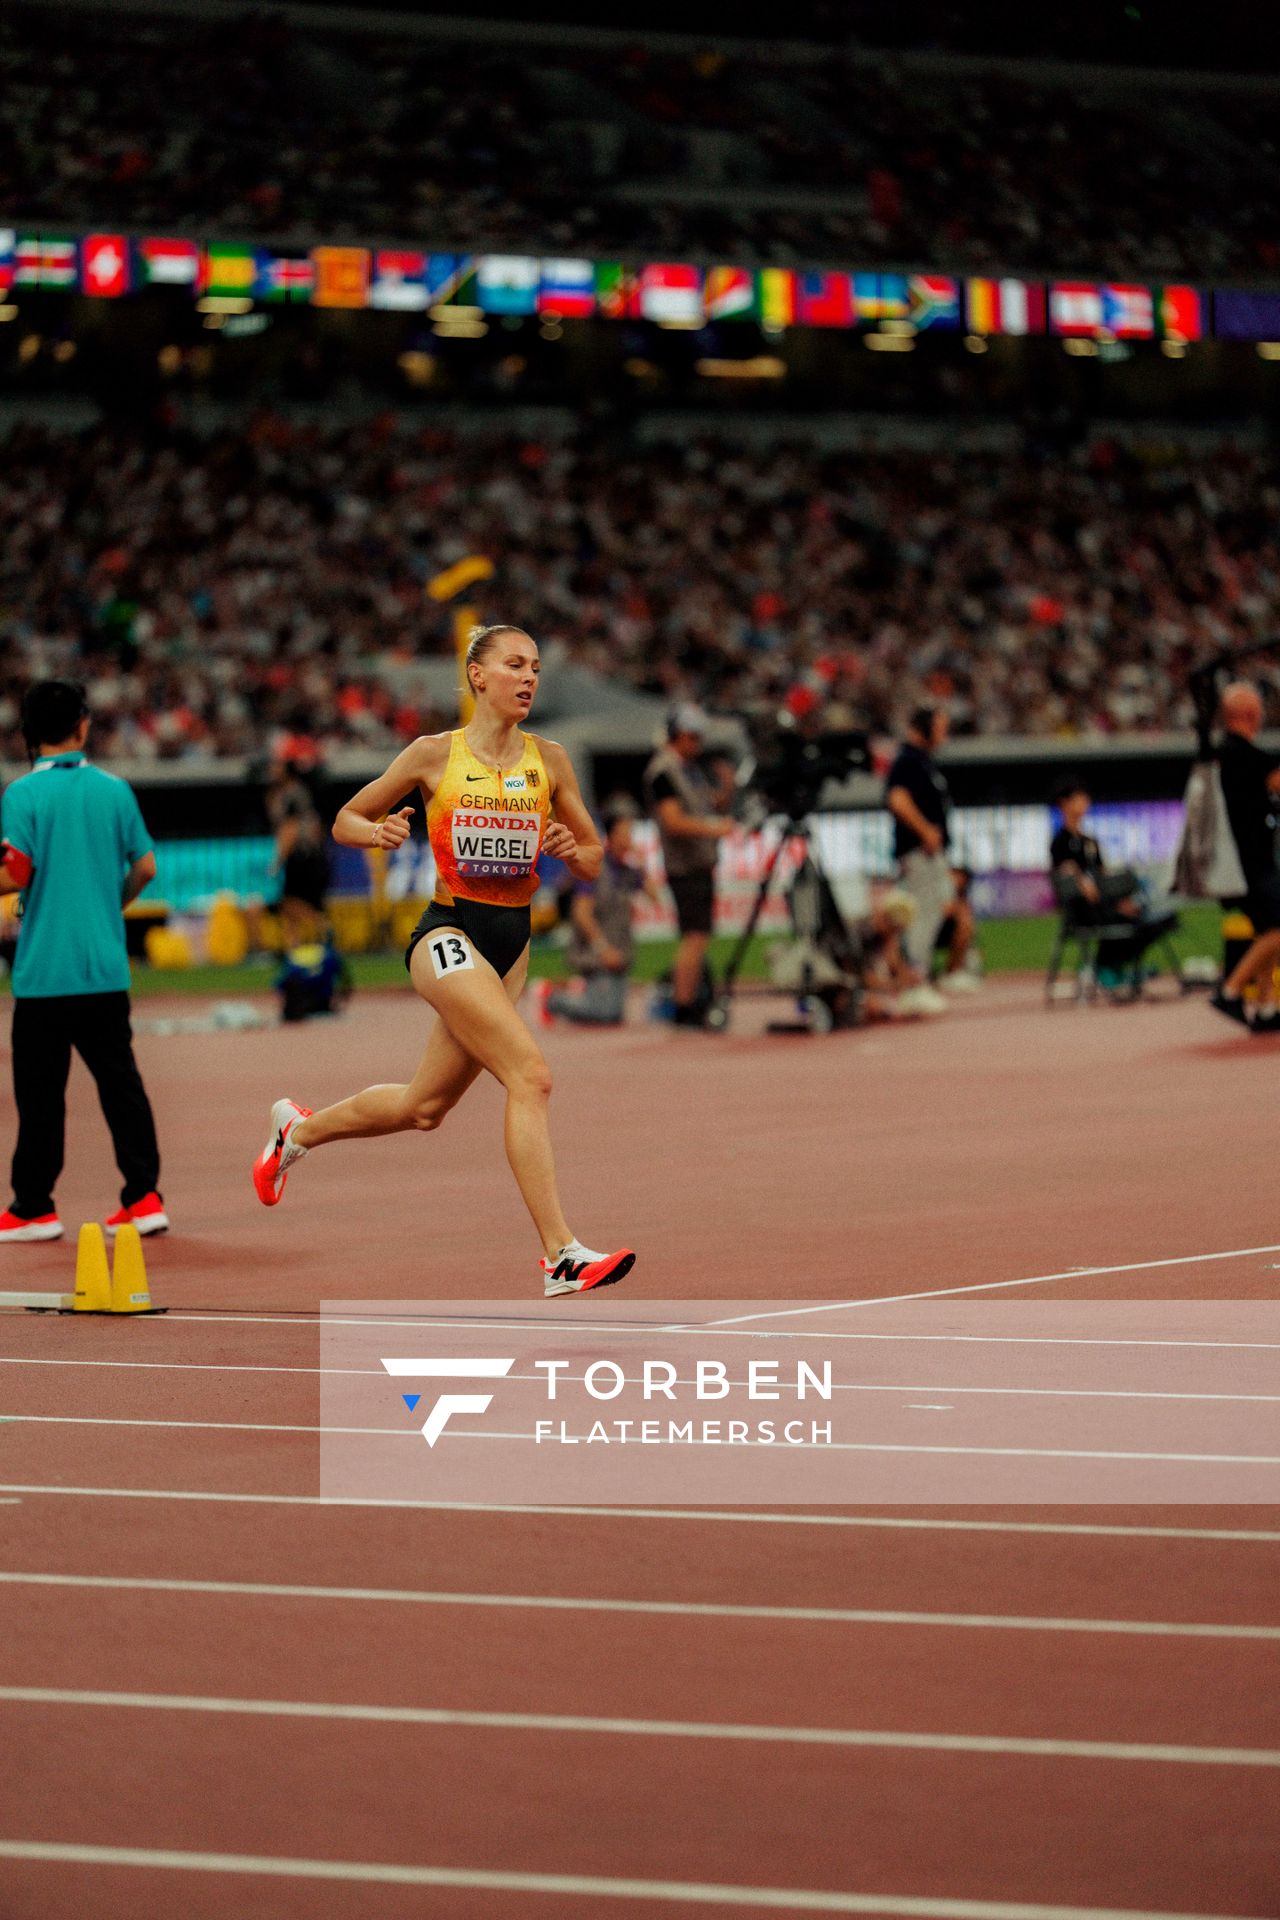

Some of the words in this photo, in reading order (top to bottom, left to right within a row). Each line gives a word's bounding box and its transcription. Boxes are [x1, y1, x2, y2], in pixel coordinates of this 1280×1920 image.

[505, 780, 525, 788] WGV
[460, 794, 539, 812] GERMANY
[454, 815, 538, 832] HONDA
[472, 864, 518, 875] TOKYO
[433, 938, 467, 970] 13
